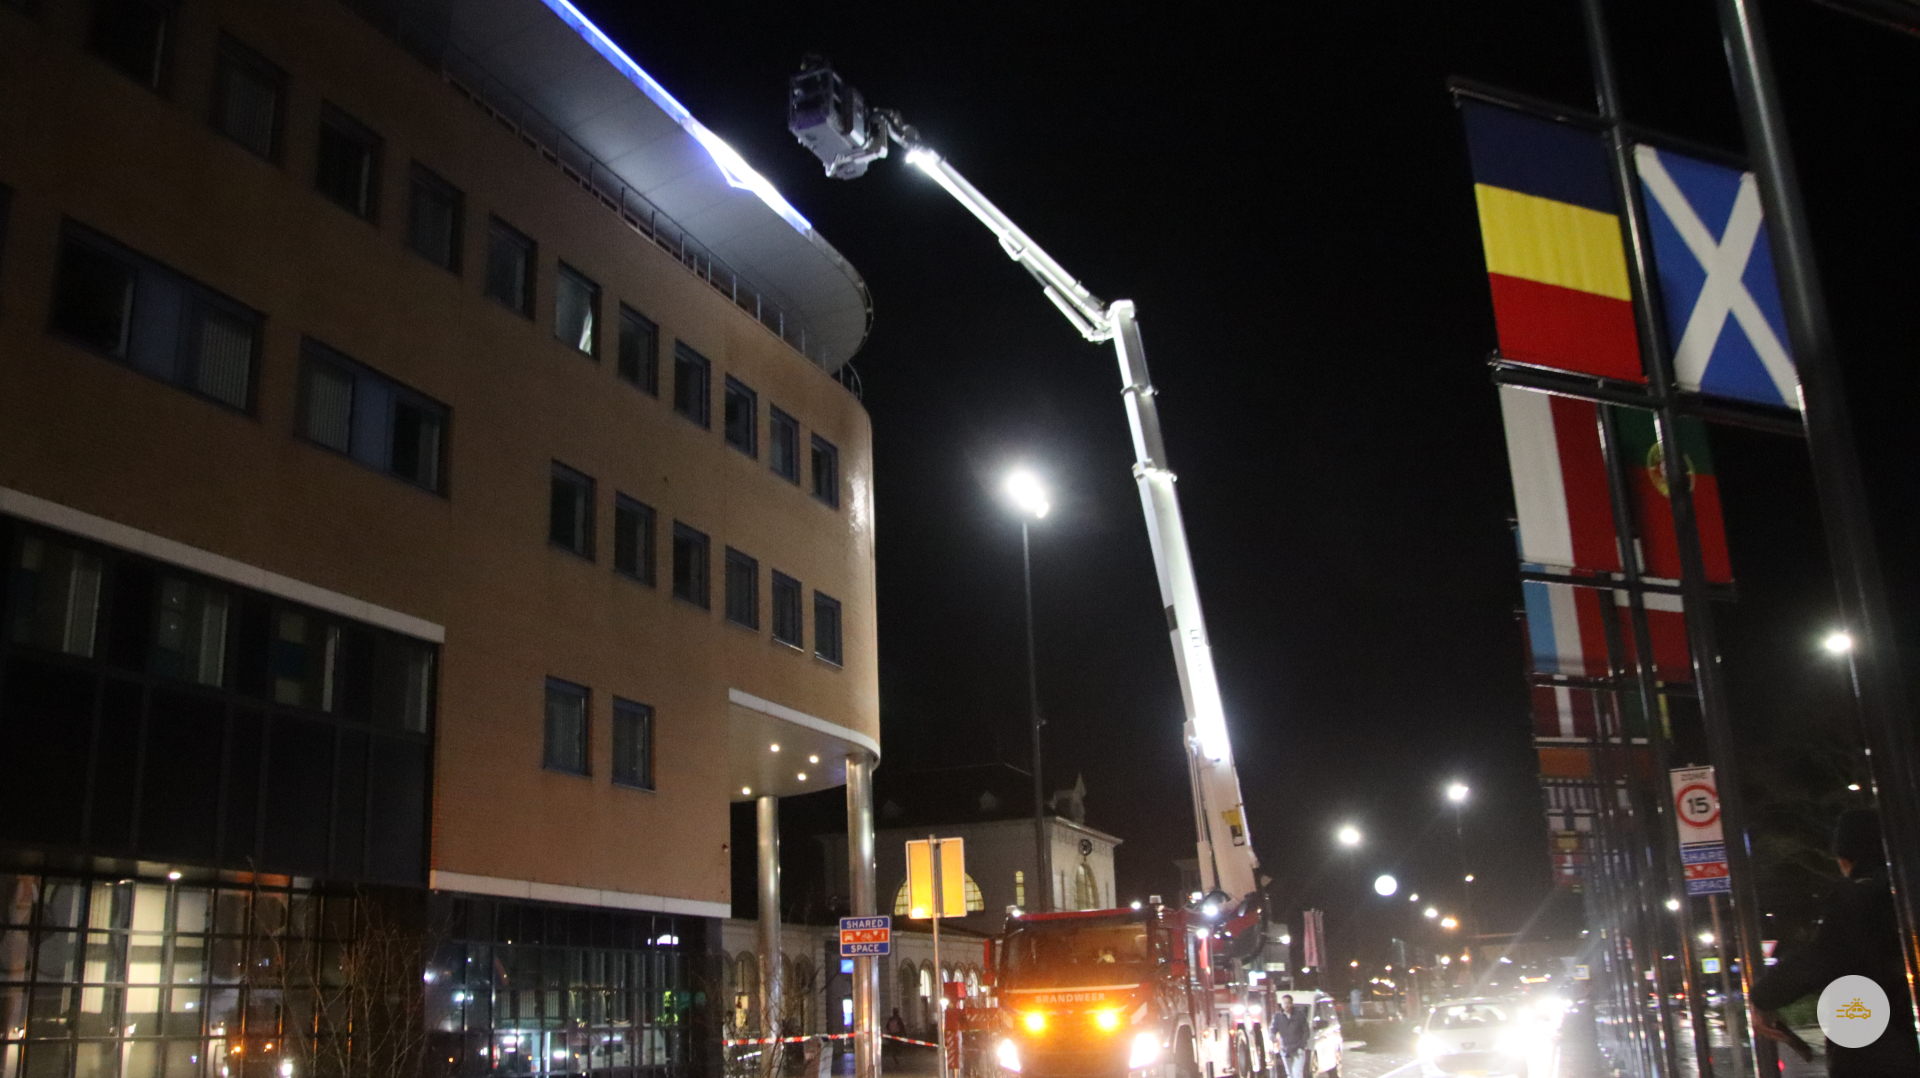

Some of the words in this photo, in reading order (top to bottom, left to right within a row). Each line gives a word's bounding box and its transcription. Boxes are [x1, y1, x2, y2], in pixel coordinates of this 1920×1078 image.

[1687, 797, 1710, 815] 15
[1681, 851, 1727, 862] SHARE
[846, 919, 883, 929] SHARED
[851, 943, 879, 953] SPACE
[1035, 993, 1105, 1003] BRANDWEER
